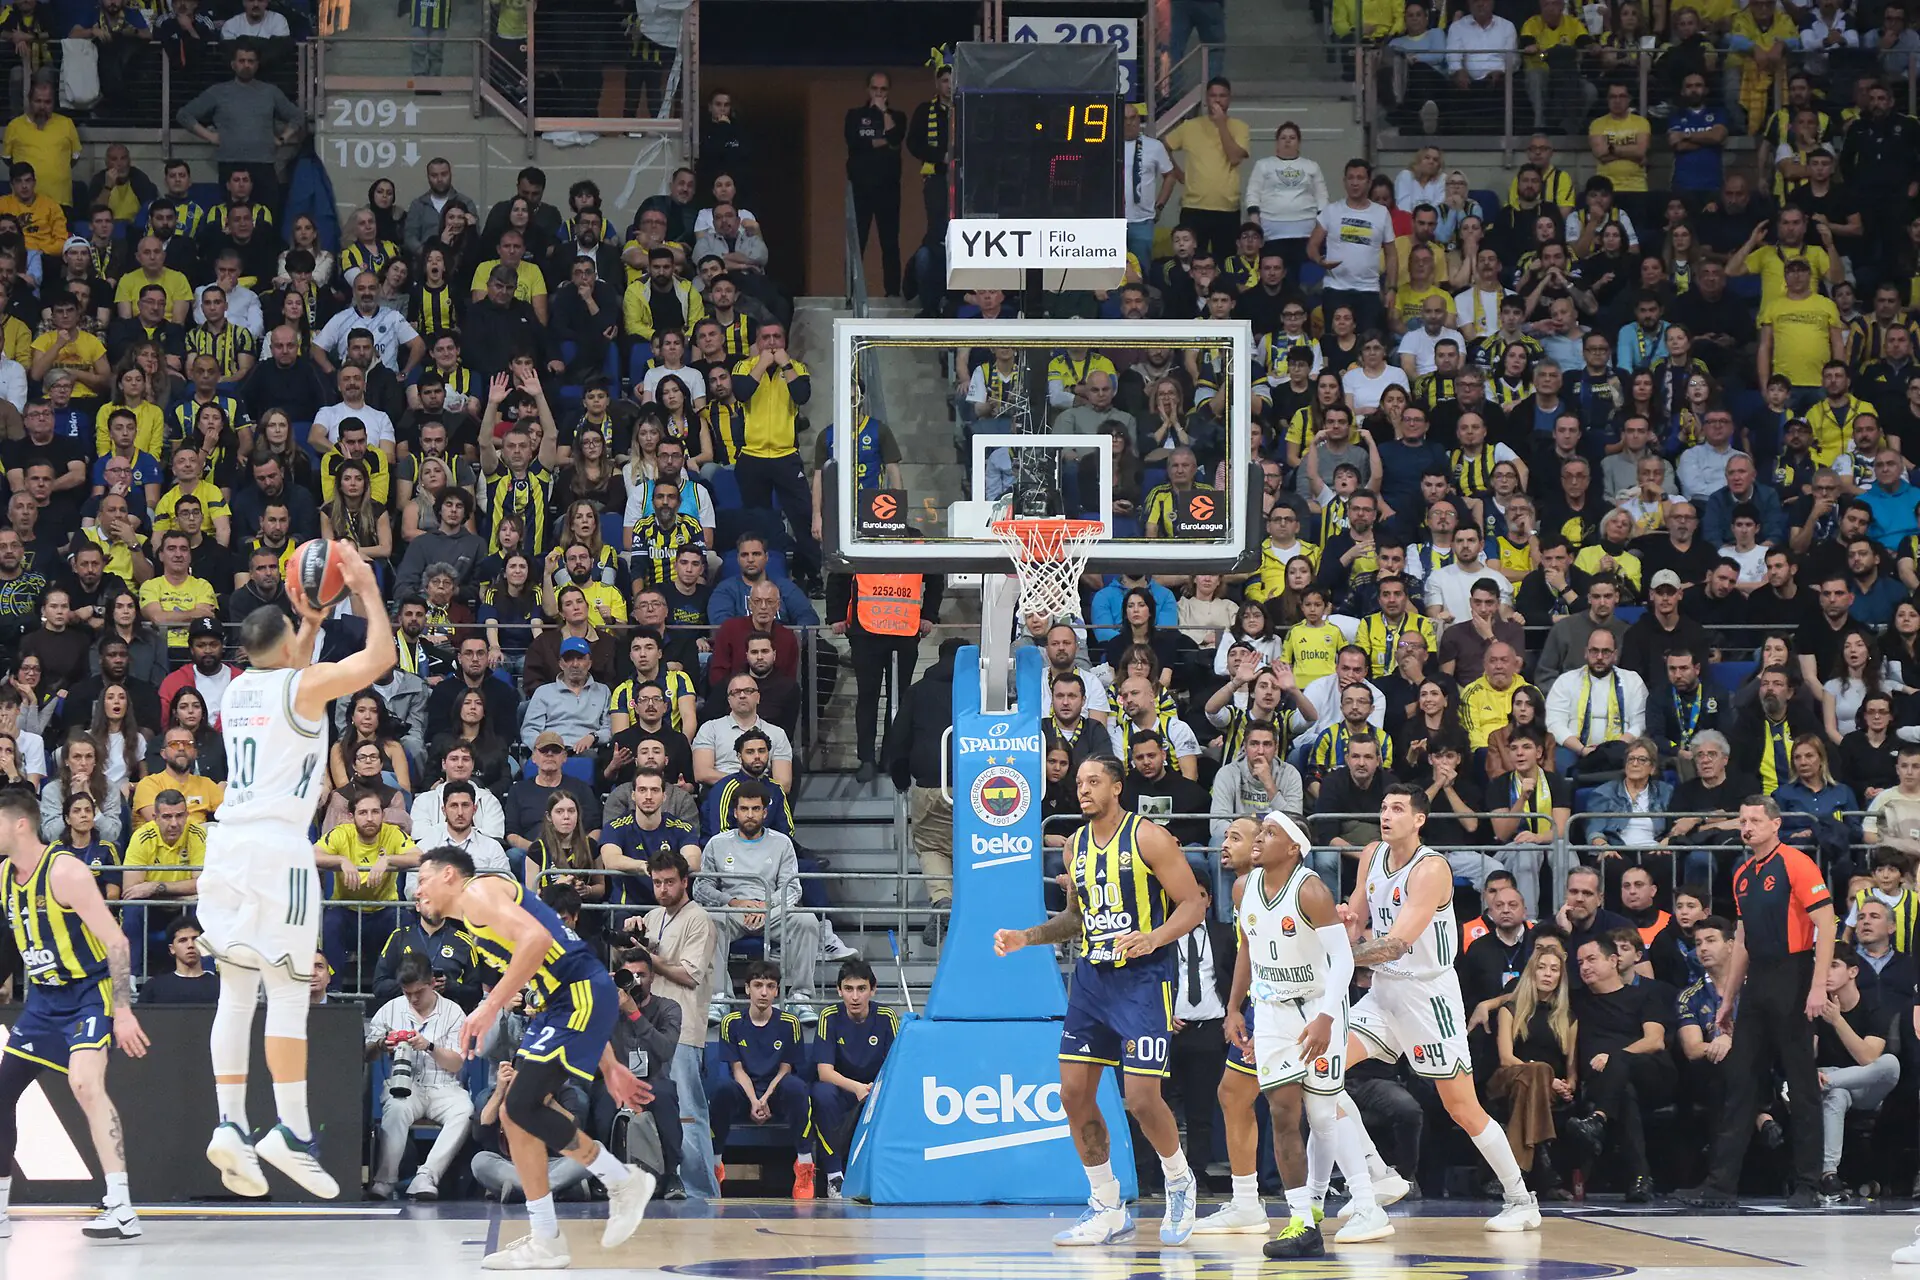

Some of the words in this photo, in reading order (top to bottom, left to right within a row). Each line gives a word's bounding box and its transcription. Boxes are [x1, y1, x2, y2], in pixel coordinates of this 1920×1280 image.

[1054, 23, 1130, 53] 208
[333, 99, 397, 127] 209
[335, 140, 397, 168] 109
[962, 230, 1032, 258] YKT
[1050, 231, 1076, 243] Filo
[1050, 246, 1117, 258] Kiralama
[862, 521, 906, 531] EuroLeague
[1180, 522, 1223, 532] EuroLeague
[872, 586, 912, 598] 2252-082
[1300, 649, 1329, 661] Otokoç
[959, 735, 1040, 754] SPALDING
[231, 736, 257, 789] 10
[972, 768, 996, 815] FENERBAHÇE
[999, 768, 1021, 782] SPOR
[992, 817, 1010, 825] 1907
[971, 832, 1033, 855] beko
[1090, 882, 1120, 909] 00
[1083, 909, 1132, 931] beko
[1378, 907, 1394, 926] 44
[23, 917, 33, 942] 1
[20, 946, 55, 966] eko
[1269, 940, 1278, 961] 0
[85, 1016, 97, 1038] 1
[529, 1026, 556, 1051] 2
[1137, 1035, 1167, 1062] 00
[1422, 1042, 1447, 1067] 44
[1331, 1054, 1340, 1080] 0
[922, 1074, 1069, 1125] beko
